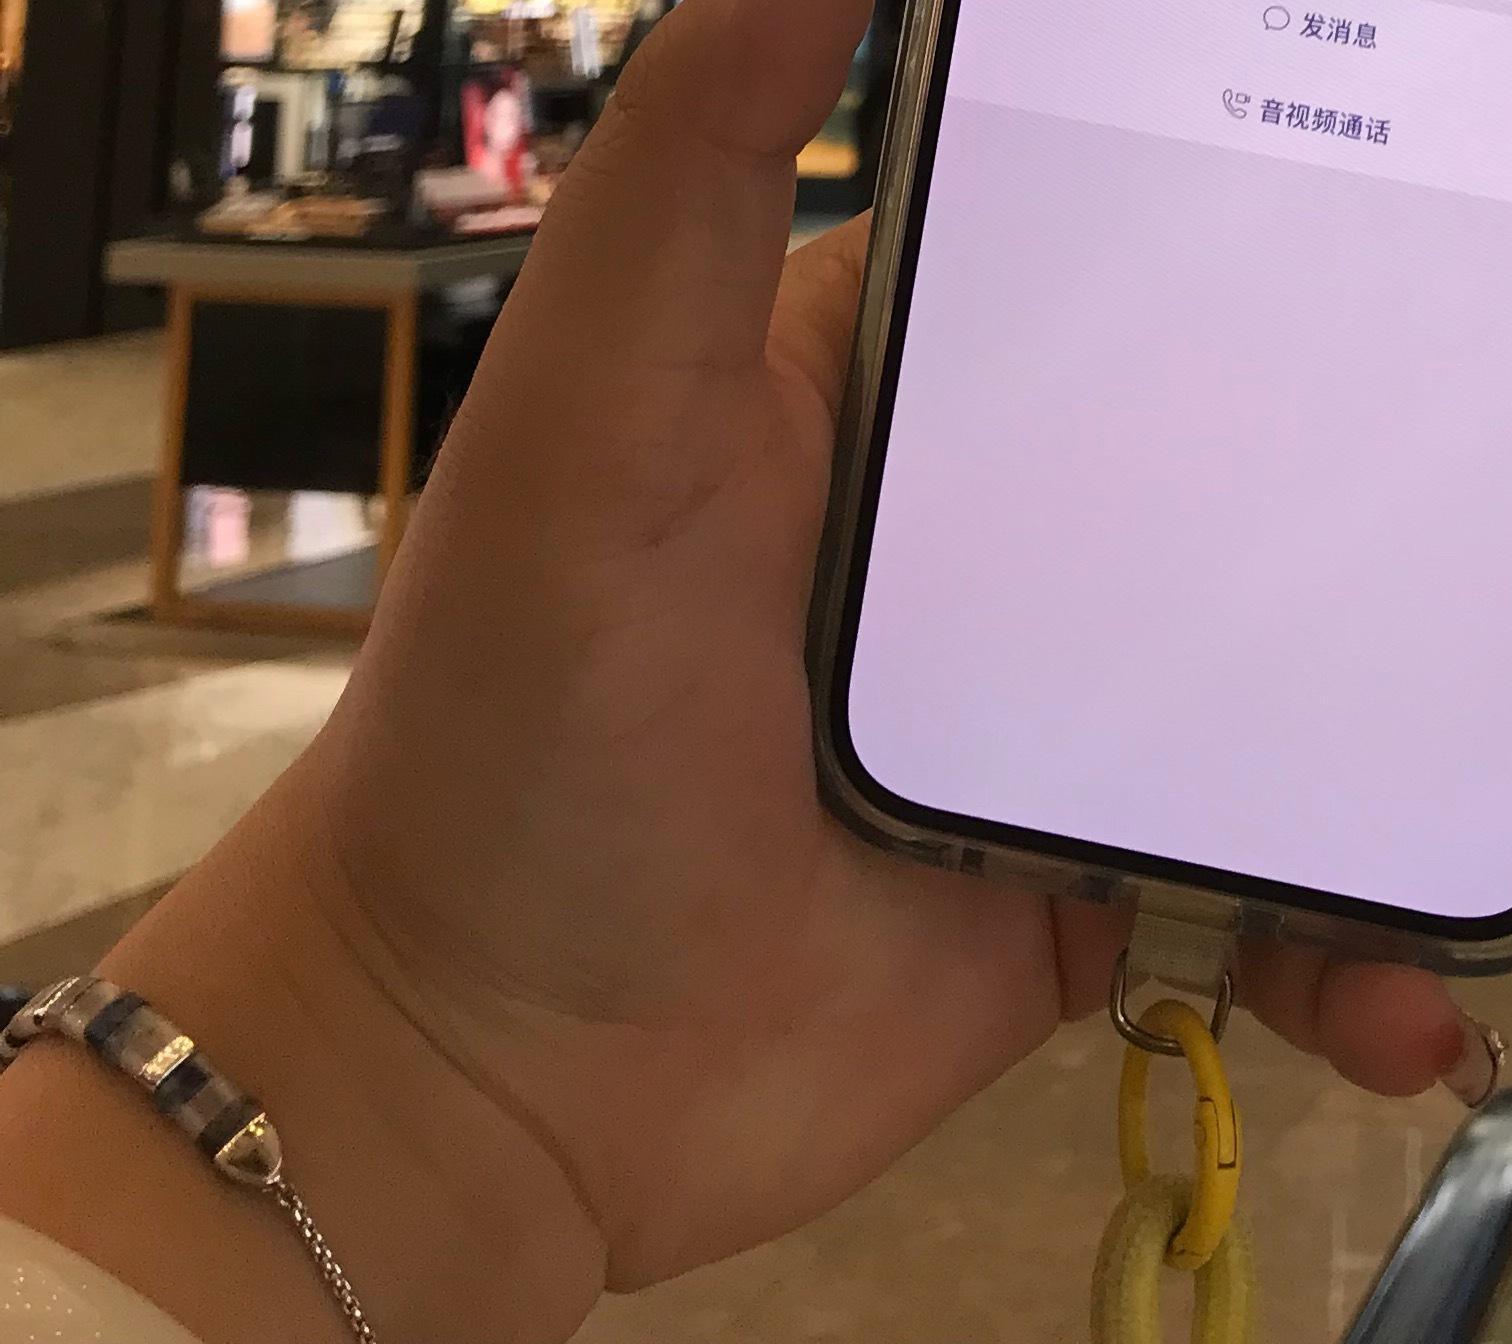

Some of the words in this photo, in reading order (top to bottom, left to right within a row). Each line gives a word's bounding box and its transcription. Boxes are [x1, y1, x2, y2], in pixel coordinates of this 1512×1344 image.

[1299, 12, 1377, 49] 发消息
[1260, 98, 1392, 146] 音视频通话
